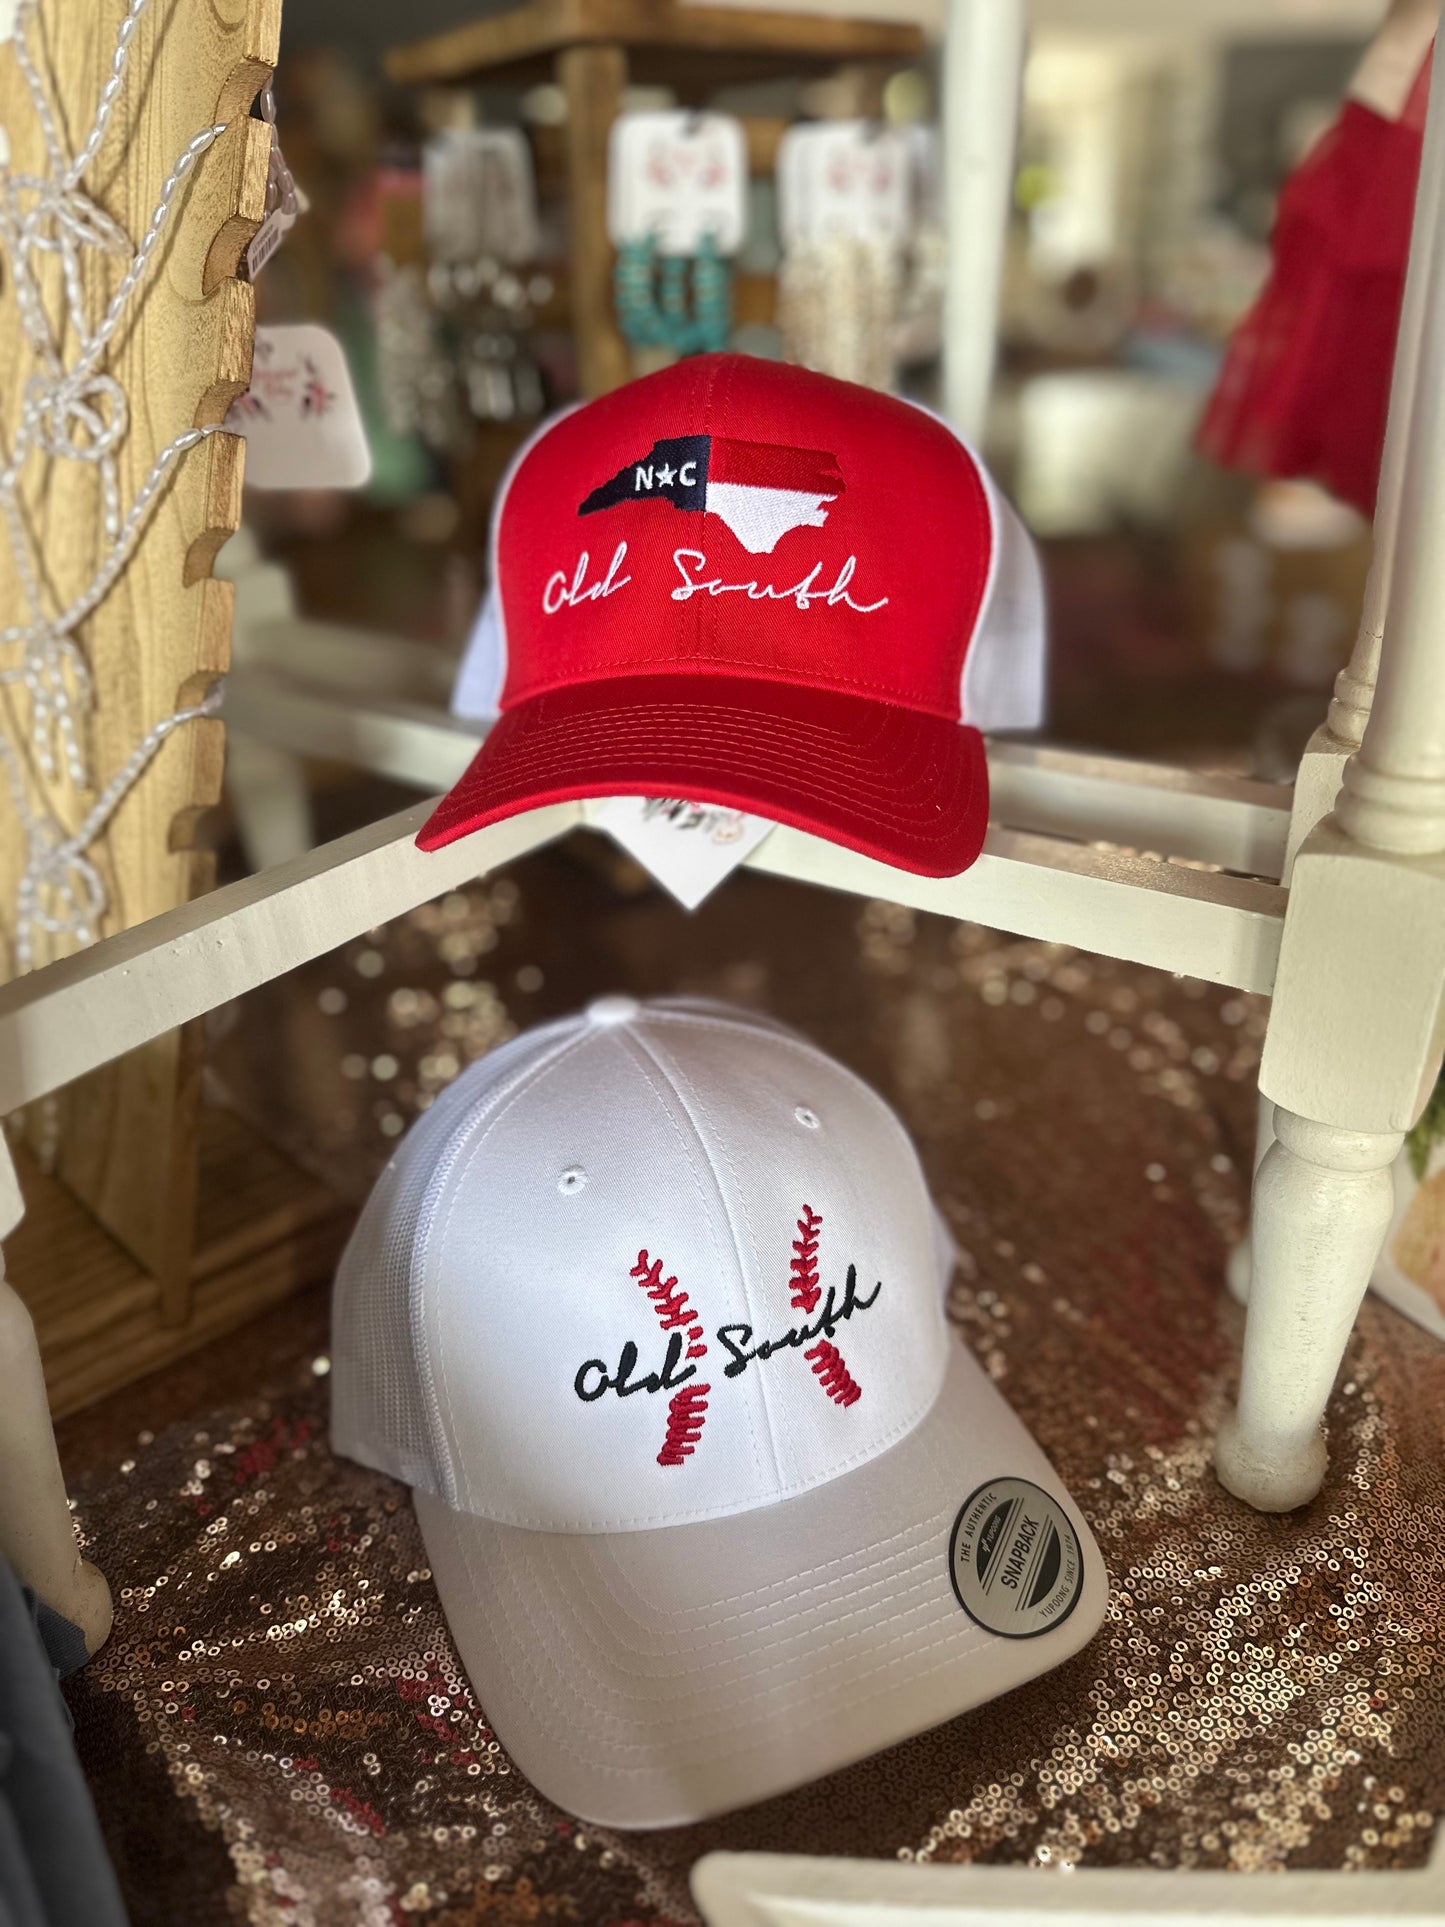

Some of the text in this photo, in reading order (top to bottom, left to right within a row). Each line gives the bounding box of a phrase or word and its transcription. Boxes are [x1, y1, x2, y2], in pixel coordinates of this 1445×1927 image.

[542, 541, 889, 614] Old South
[573, 1263, 882, 1402] Old South
[960, 1492, 998, 1563] THE AUTHENTIC
[1000, 1514, 1040, 1590] SNAPBACK
[1038, 1584, 1070, 1618] YUPOONG
[1064, 1559, 1076, 1585] SINCE
